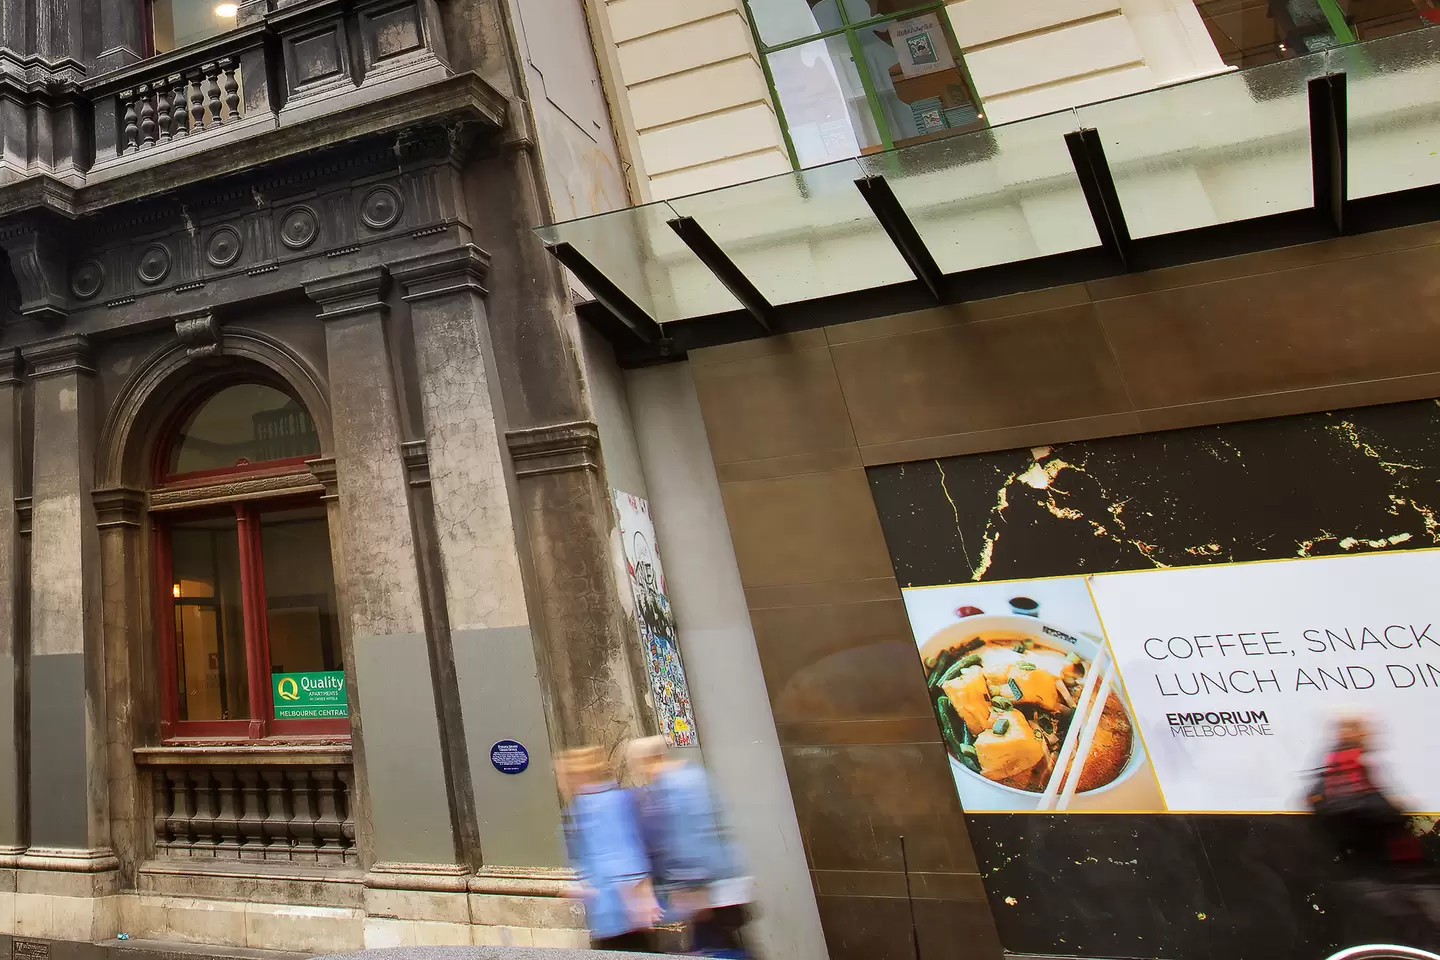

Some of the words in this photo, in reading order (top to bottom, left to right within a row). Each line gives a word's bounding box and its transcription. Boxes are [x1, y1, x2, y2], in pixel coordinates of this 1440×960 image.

[1144, 631, 1296, 660] COFFEE,
[1303, 623, 1440, 653] SNACK
[301, 676, 344, 692] Quality
[1155, 669, 1281, 696] LUNCH
[1296, 665, 1375, 691] AND
[1166, 711, 1269, 726] EMPORIUM
[1170, 724, 1274, 737] MELBOURNE
